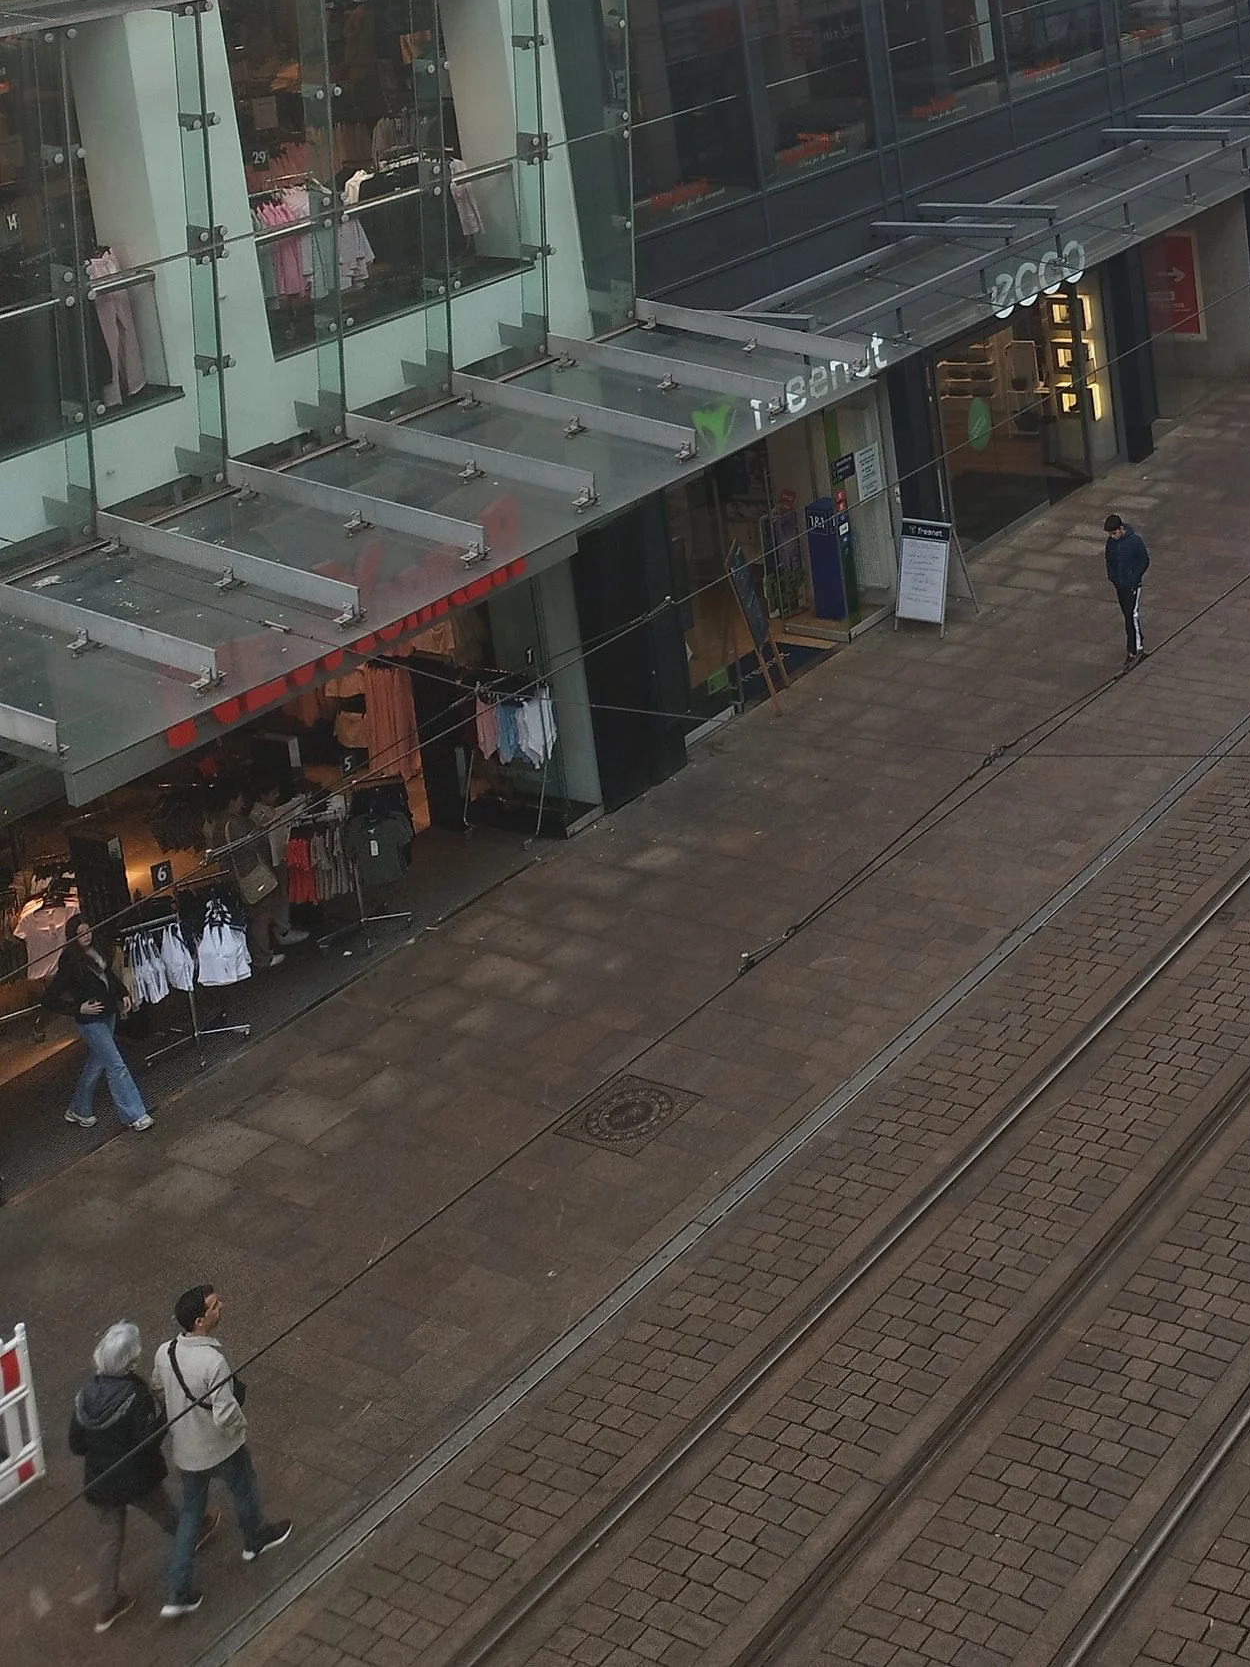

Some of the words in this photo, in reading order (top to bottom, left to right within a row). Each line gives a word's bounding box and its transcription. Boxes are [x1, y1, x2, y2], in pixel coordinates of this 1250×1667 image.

[252, 151, 266, 165] 29
[809, 515, 825, 529] 1&1
[343, 755, 353, 771] 5
[156, 865, 168, 882] 6
